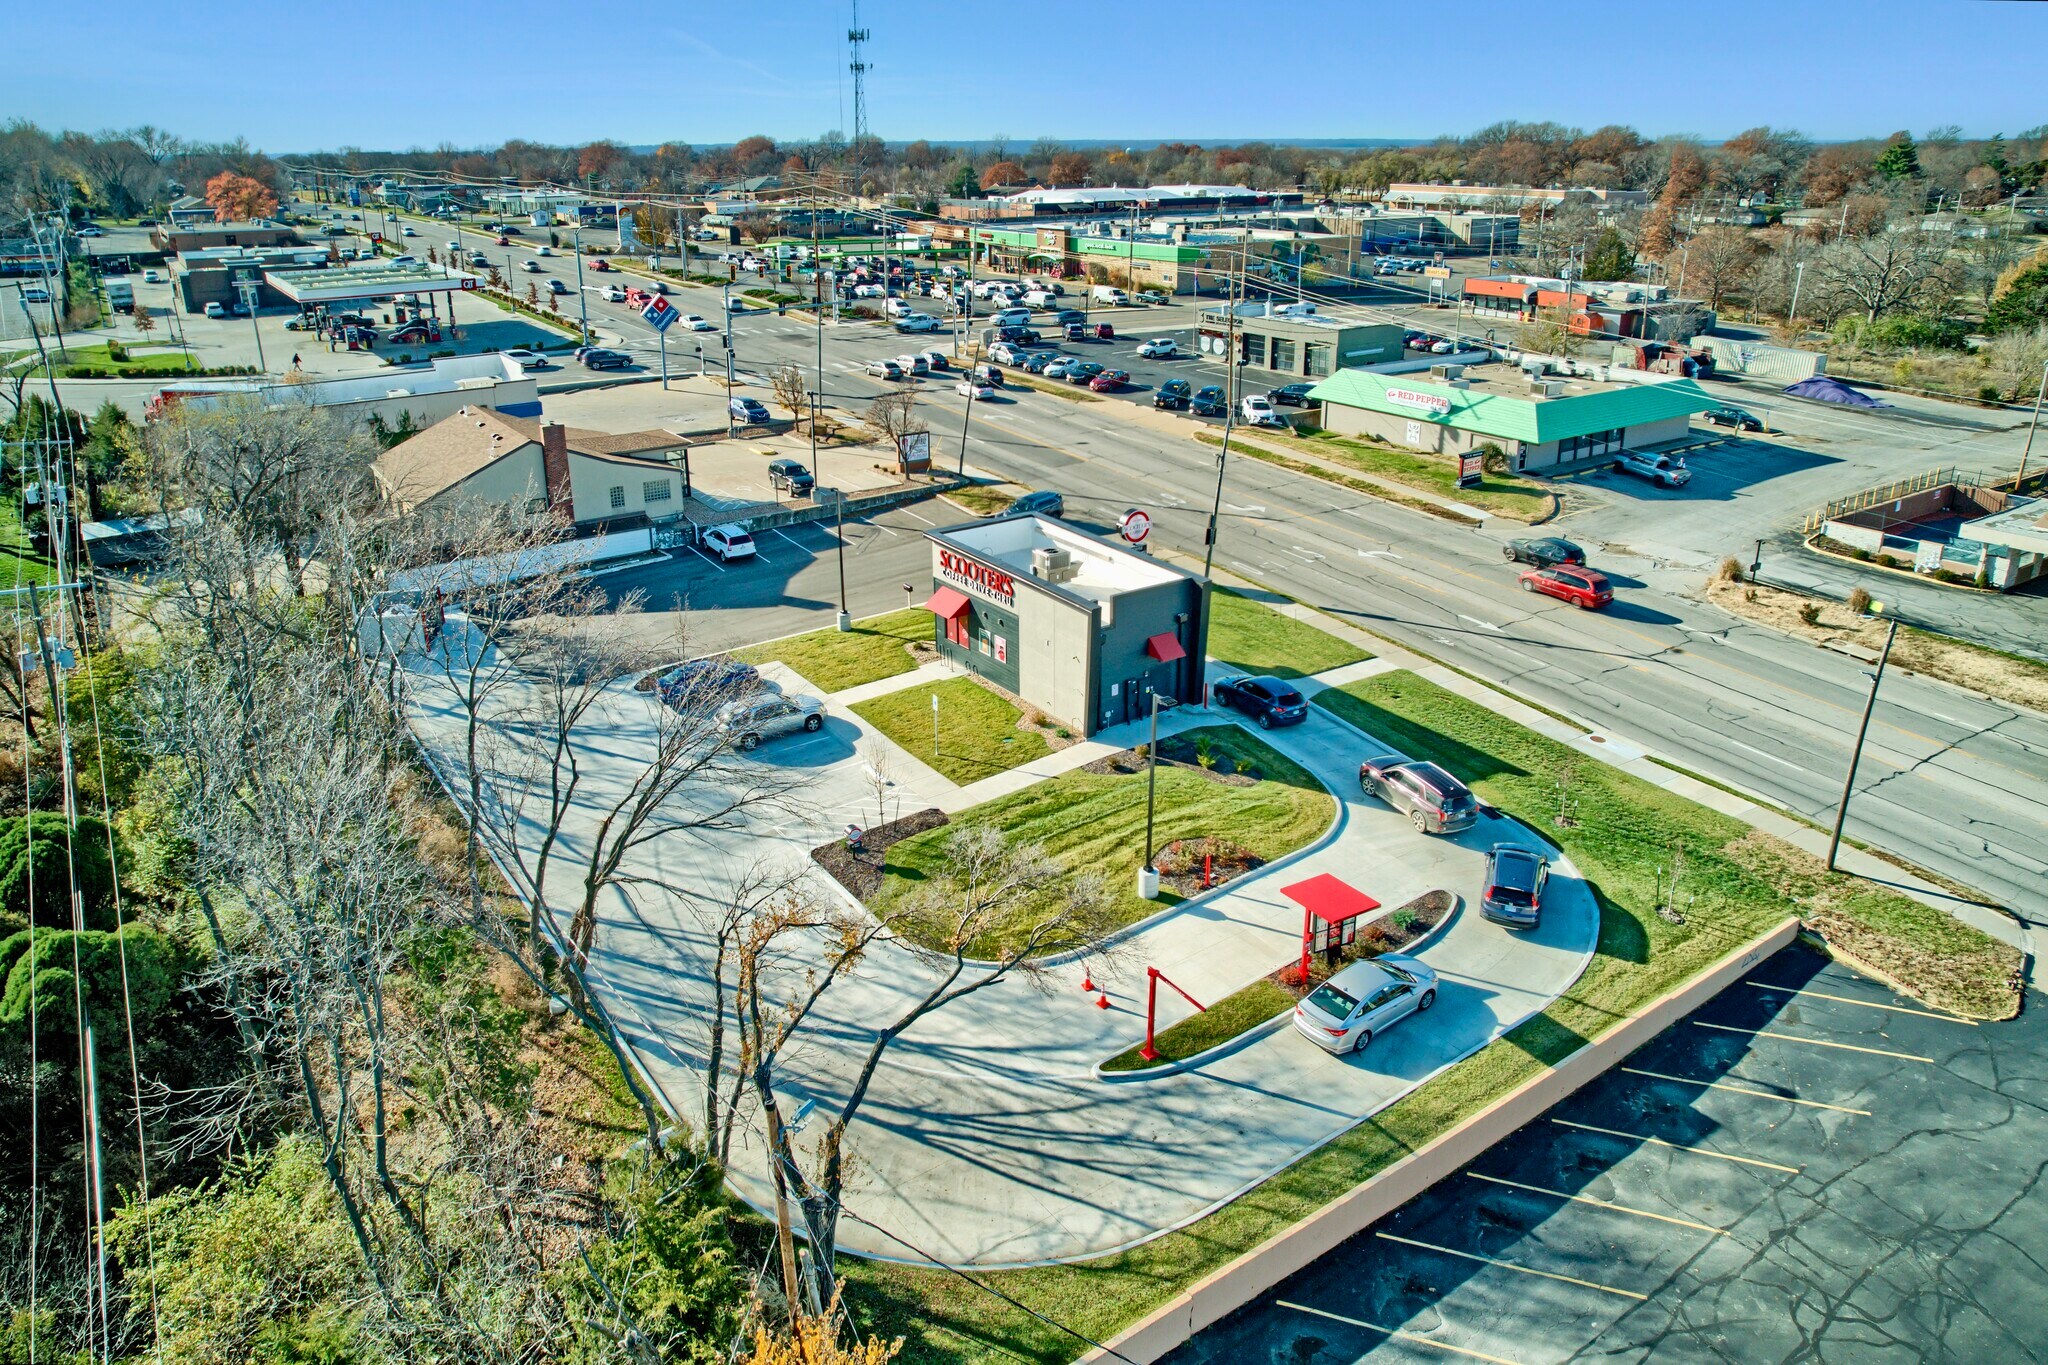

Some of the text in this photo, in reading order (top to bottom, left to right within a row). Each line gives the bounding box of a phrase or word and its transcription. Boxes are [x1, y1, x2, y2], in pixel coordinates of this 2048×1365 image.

[463, 280, 473, 288] QT
[658, 310, 675, 328] Domino's
[1398, 391, 1414, 400] RED
[1416, 394, 1447, 407] PEPPER
[940, 549, 1014, 597] SCOOTER'S
[942, 568, 969, 588] COFFEE
